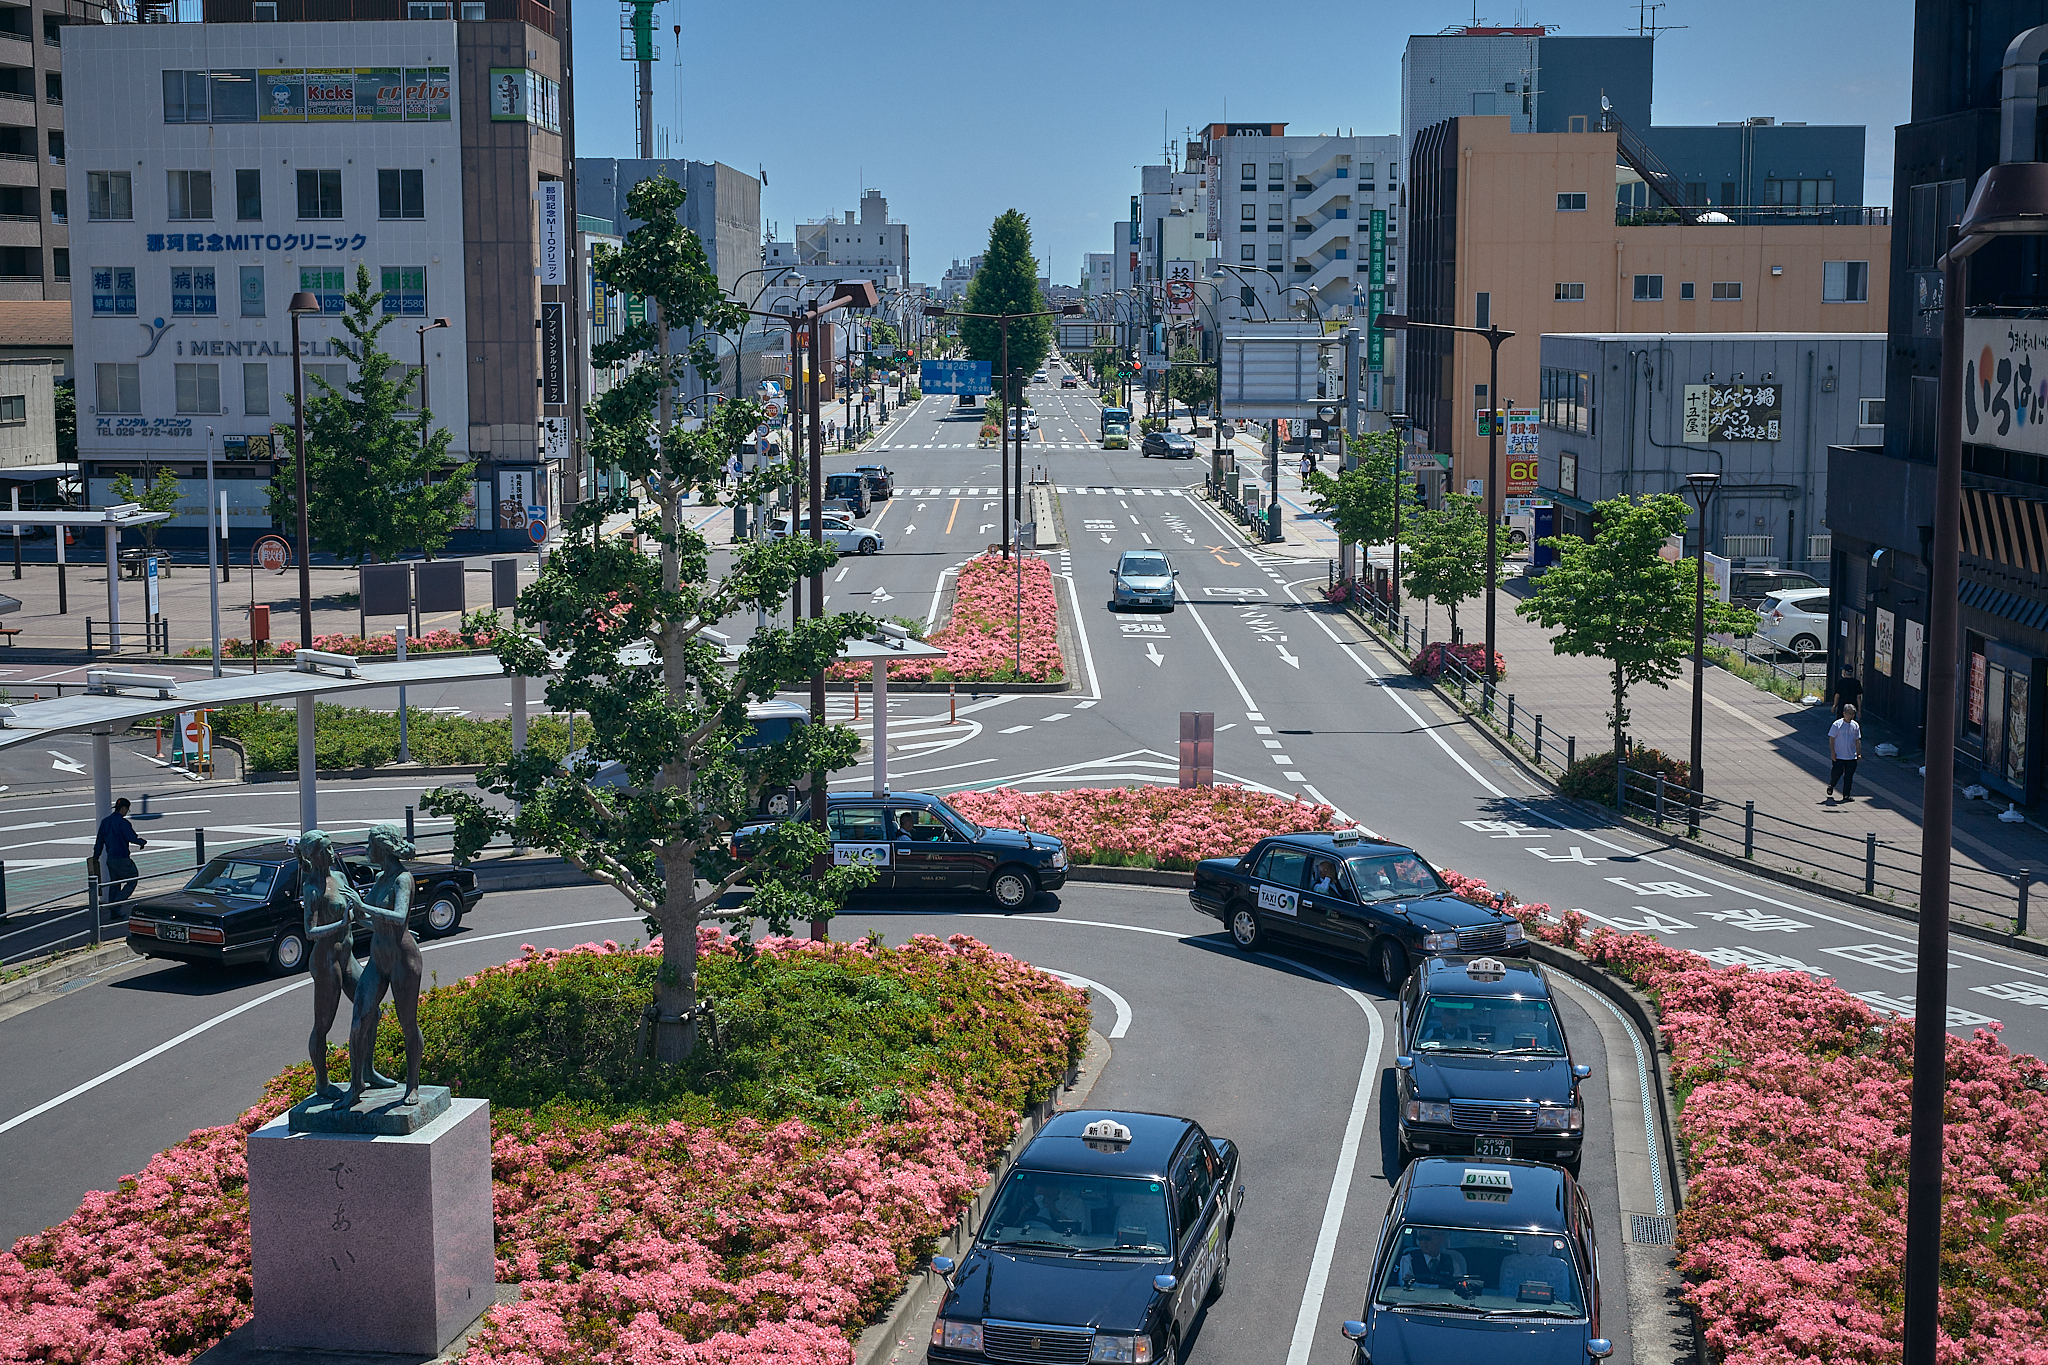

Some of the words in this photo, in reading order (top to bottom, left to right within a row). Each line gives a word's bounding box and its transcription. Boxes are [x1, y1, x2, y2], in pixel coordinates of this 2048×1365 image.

[308, 84, 353, 100] Kicks
[545, 186, 557, 280] 那珂記念MITOクリニック
[146, 233, 367, 252] 那珂記念MITOクリニック
[1372, 293, 1381, 362] 東進予備校
[548, 320, 558, 402] アイメンタルクリニック
[936, 362, 977, 371] 国道245号
[967, 376, 988, 384] 水戸
[1710, 387, 1775, 408] あんこう鍋
[1686, 392, 1701, 433] 十五屋
[1710, 408, 1750, 426] あんこう
[96, 418, 111, 427] アイ
[117, 418, 149, 427] メンタル
[153, 418, 192, 427] クリニック
[96, 428, 113, 436] TEL
[116, 428, 193, 437] 029-272-4976
[1722, 425, 1766, 441] 水炊き
[1261, 891, 1277, 905] TAXI
[1088, 1126, 1098, 1136] 新
[1114, 1128, 1123, 1138] 星
[1482, 1145, 1511, 1156] 21-70
[1478, 1175, 1507, 1185] TAXI
[328, 1162, 356, 1271] であい
